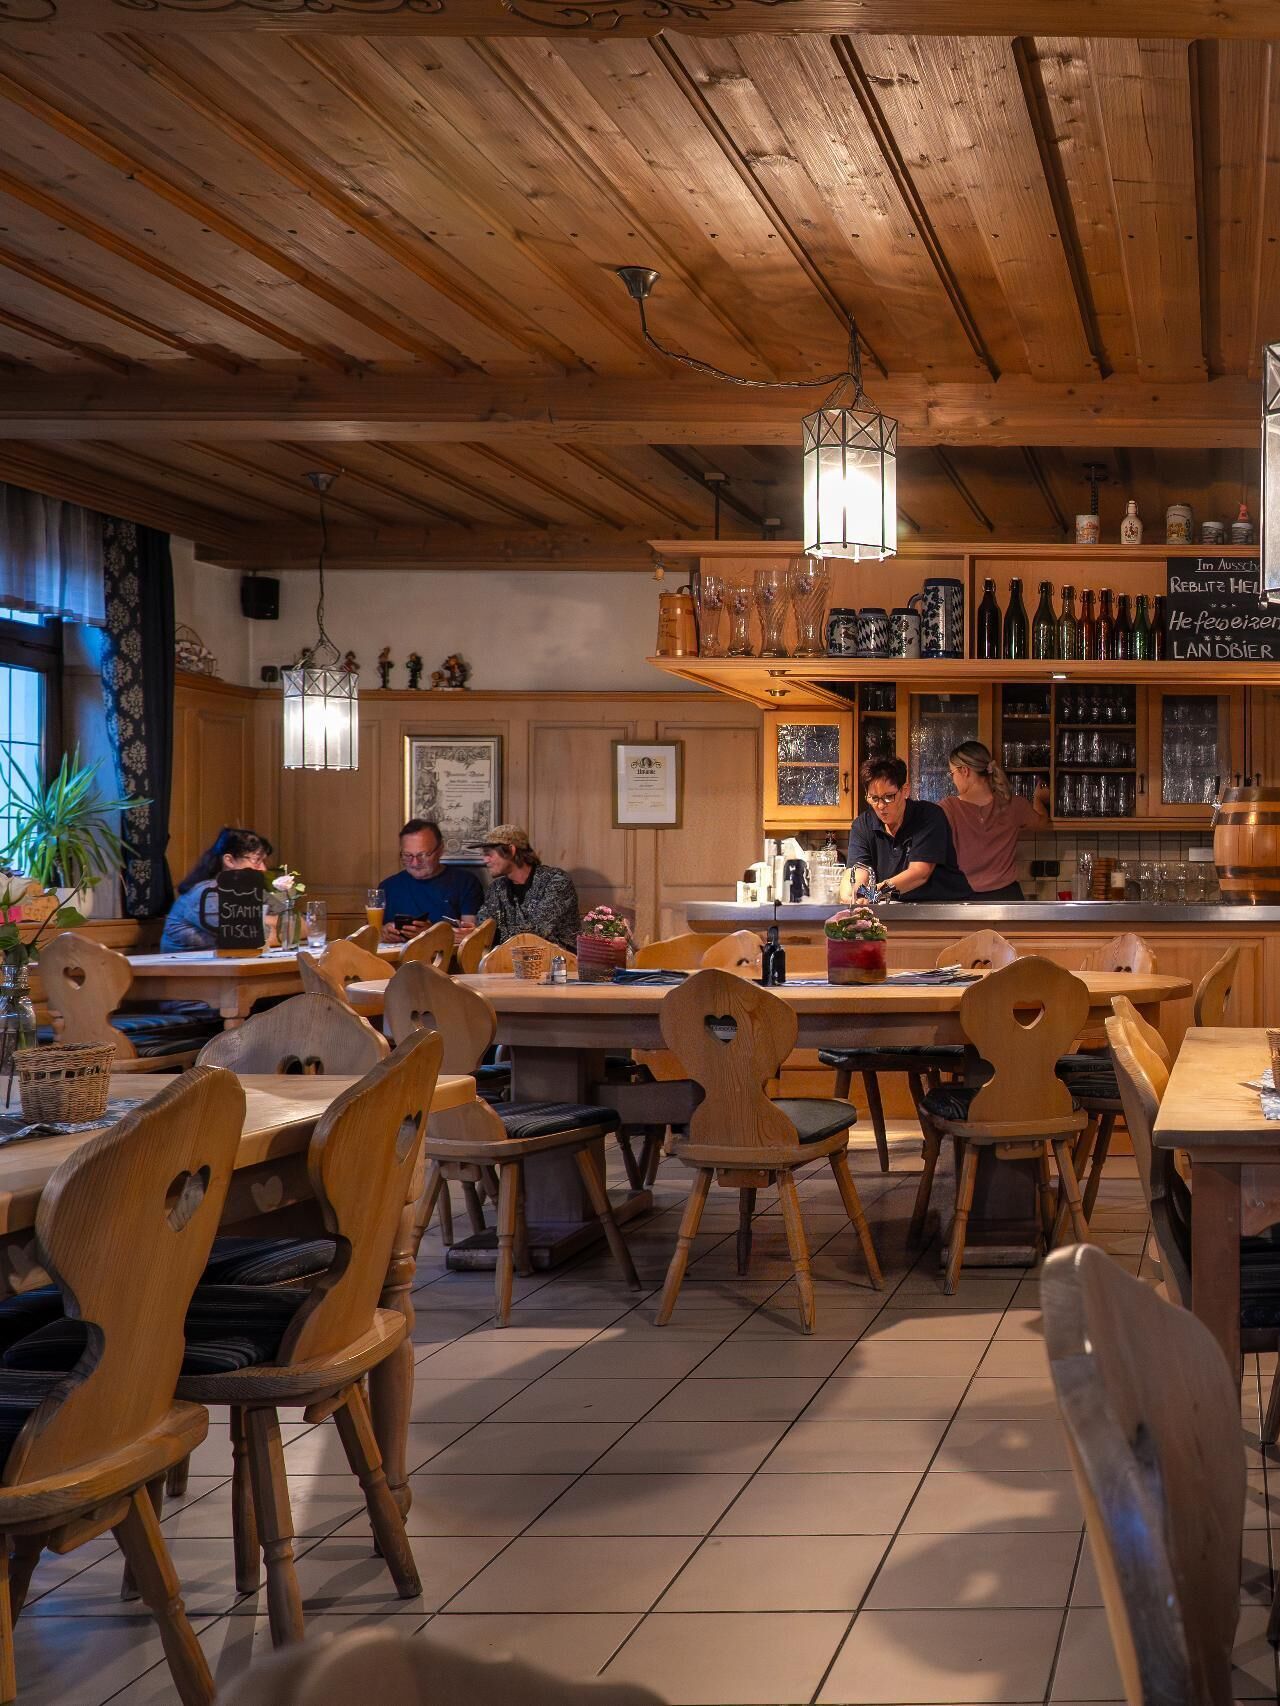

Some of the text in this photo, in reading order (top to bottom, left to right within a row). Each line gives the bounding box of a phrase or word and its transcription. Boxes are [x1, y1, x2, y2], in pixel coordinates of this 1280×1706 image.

[1196, 558, 1260, 573] Im Aussch
[1230, 577, 1261, 595] HEL
[220, 902, 262, 919] STAMM
[220, 924, 259, 938] TISCH
